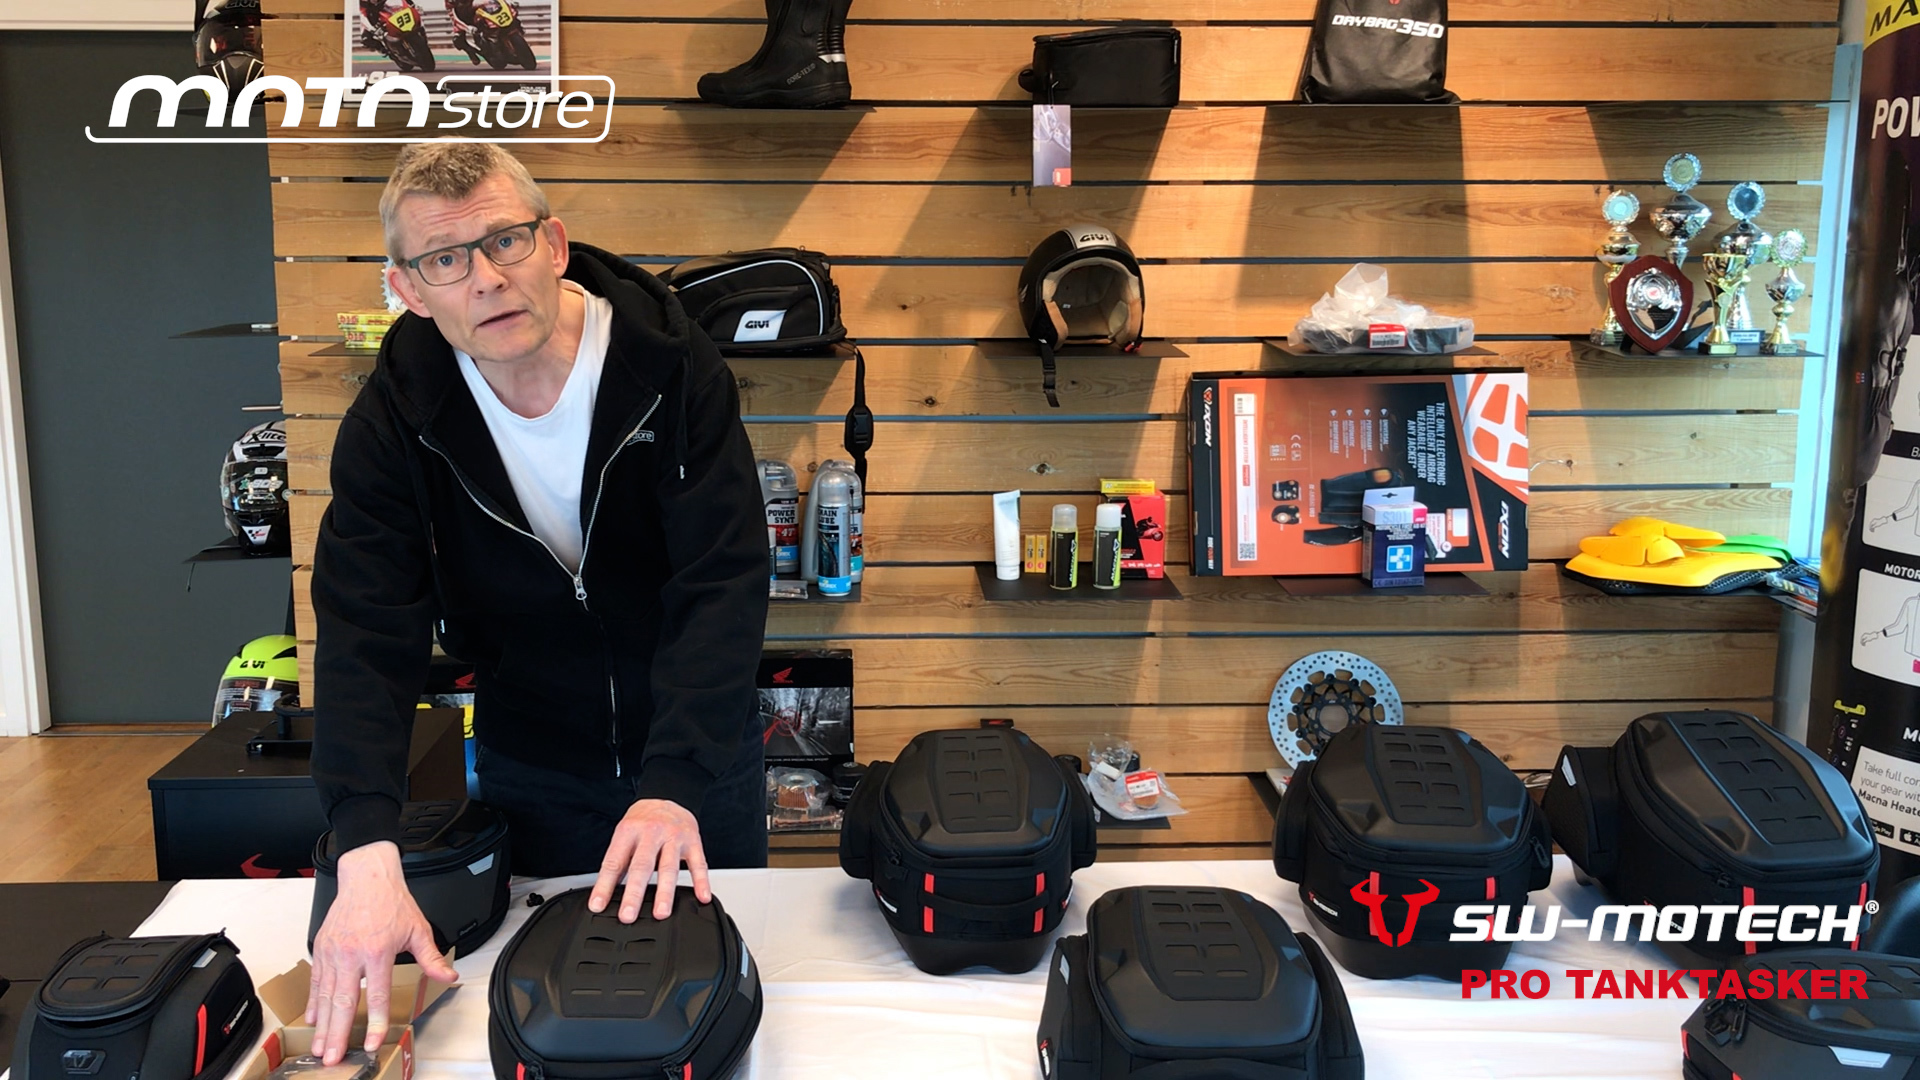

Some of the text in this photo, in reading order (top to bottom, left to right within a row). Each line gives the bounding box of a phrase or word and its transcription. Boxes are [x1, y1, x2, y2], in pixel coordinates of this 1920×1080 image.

[397, 12, 412, 28] 93
[497, 12, 511, 26] 23
[1080, 233, 1110, 243] GIVI
[744, 320, 770, 329] GIVI
[1202, 404, 1212, 448] IXON
[1406, 420, 1417, 436] ANY
[1416, 410, 1427, 479] WEARABLE UNDER
[1426, 405, 1437, 483] INTELLIGENT AIRBAG
[1435, 402, 1447, 486] THE ONLY ELECTRONIC
[767, 509, 796, 518] POWER
[1499, 500, 1509, 559] IXON
[1864, 760, 1884, 776] Take
[1886, 768, 1902, 783] full
[1860, 777, 1880, 789] your
[1881, 784, 1903, 797] gear
[1858, 788, 1888, 808] Macna
